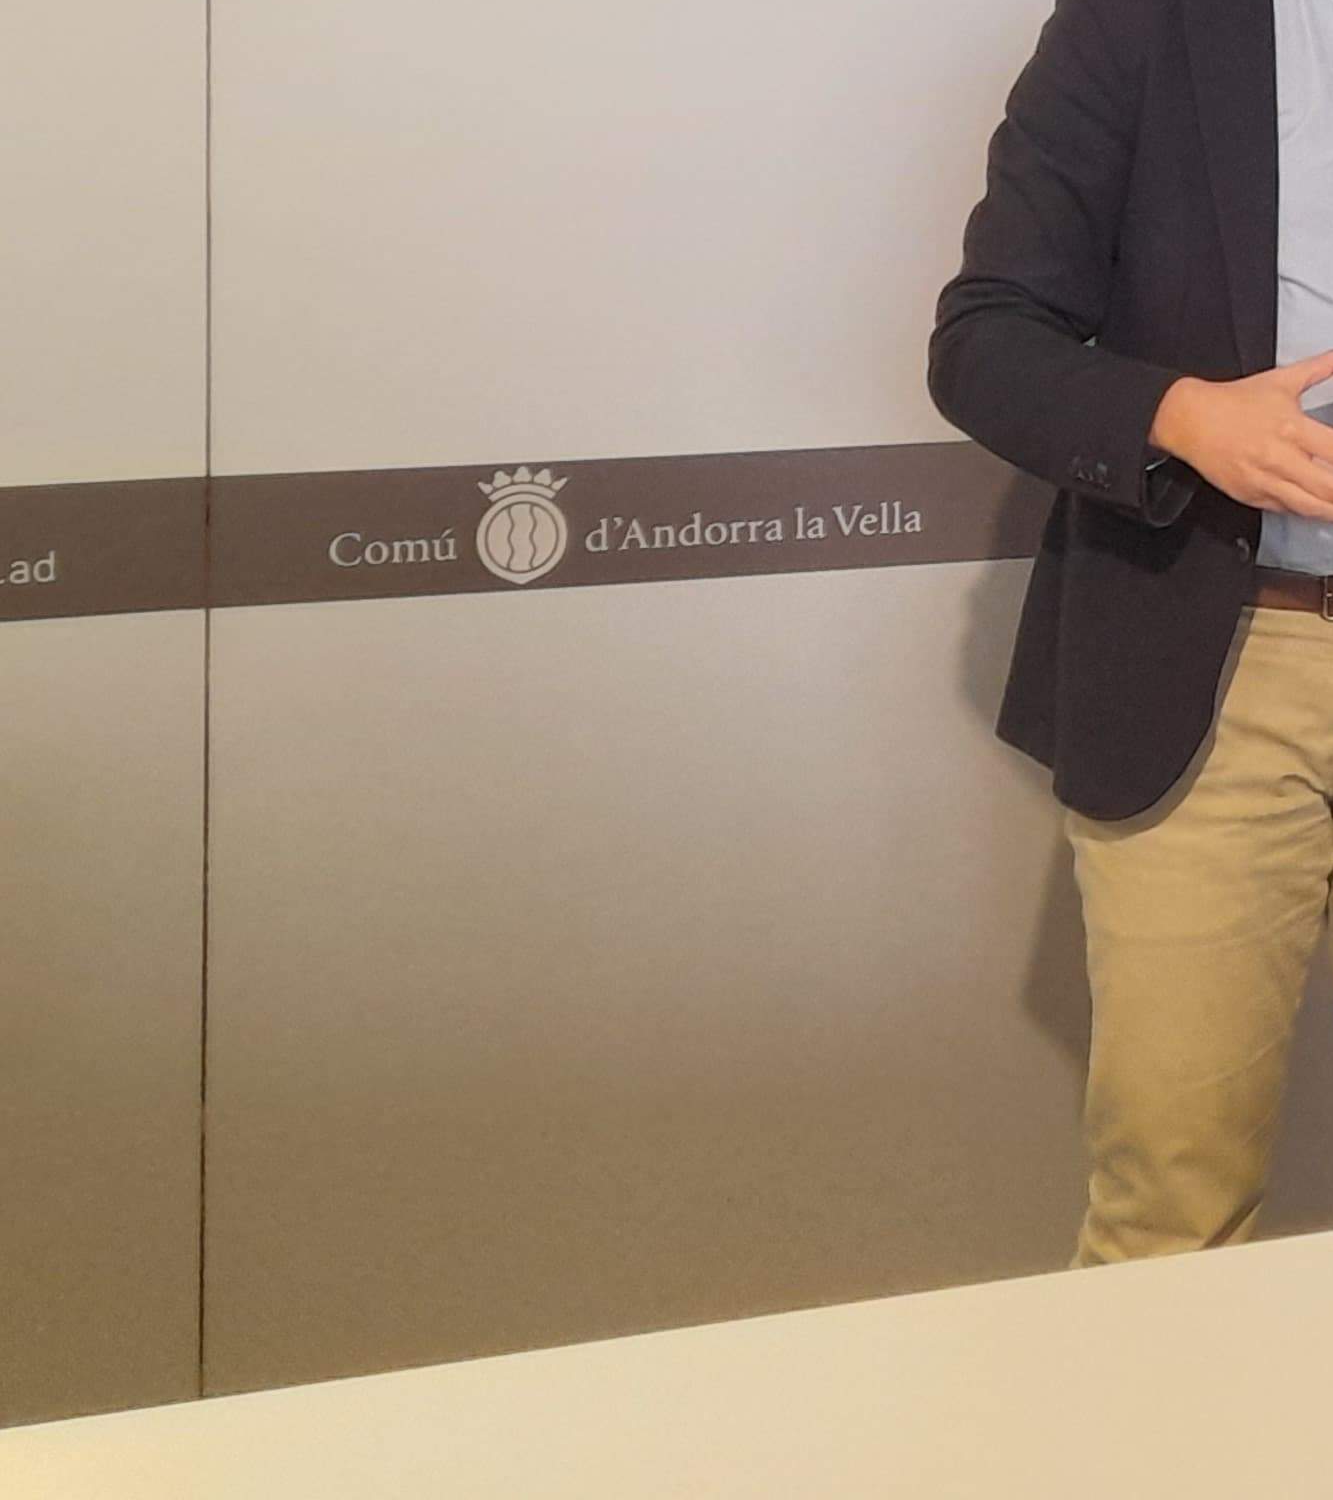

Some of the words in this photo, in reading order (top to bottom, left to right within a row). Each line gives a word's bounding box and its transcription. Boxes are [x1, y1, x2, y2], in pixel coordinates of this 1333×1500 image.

[329, 529, 457, 566] Comú
[585, 512, 784, 552] d'Andorra
[795, 507, 826, 540] la
[832, 501, 922, 536] Vella
